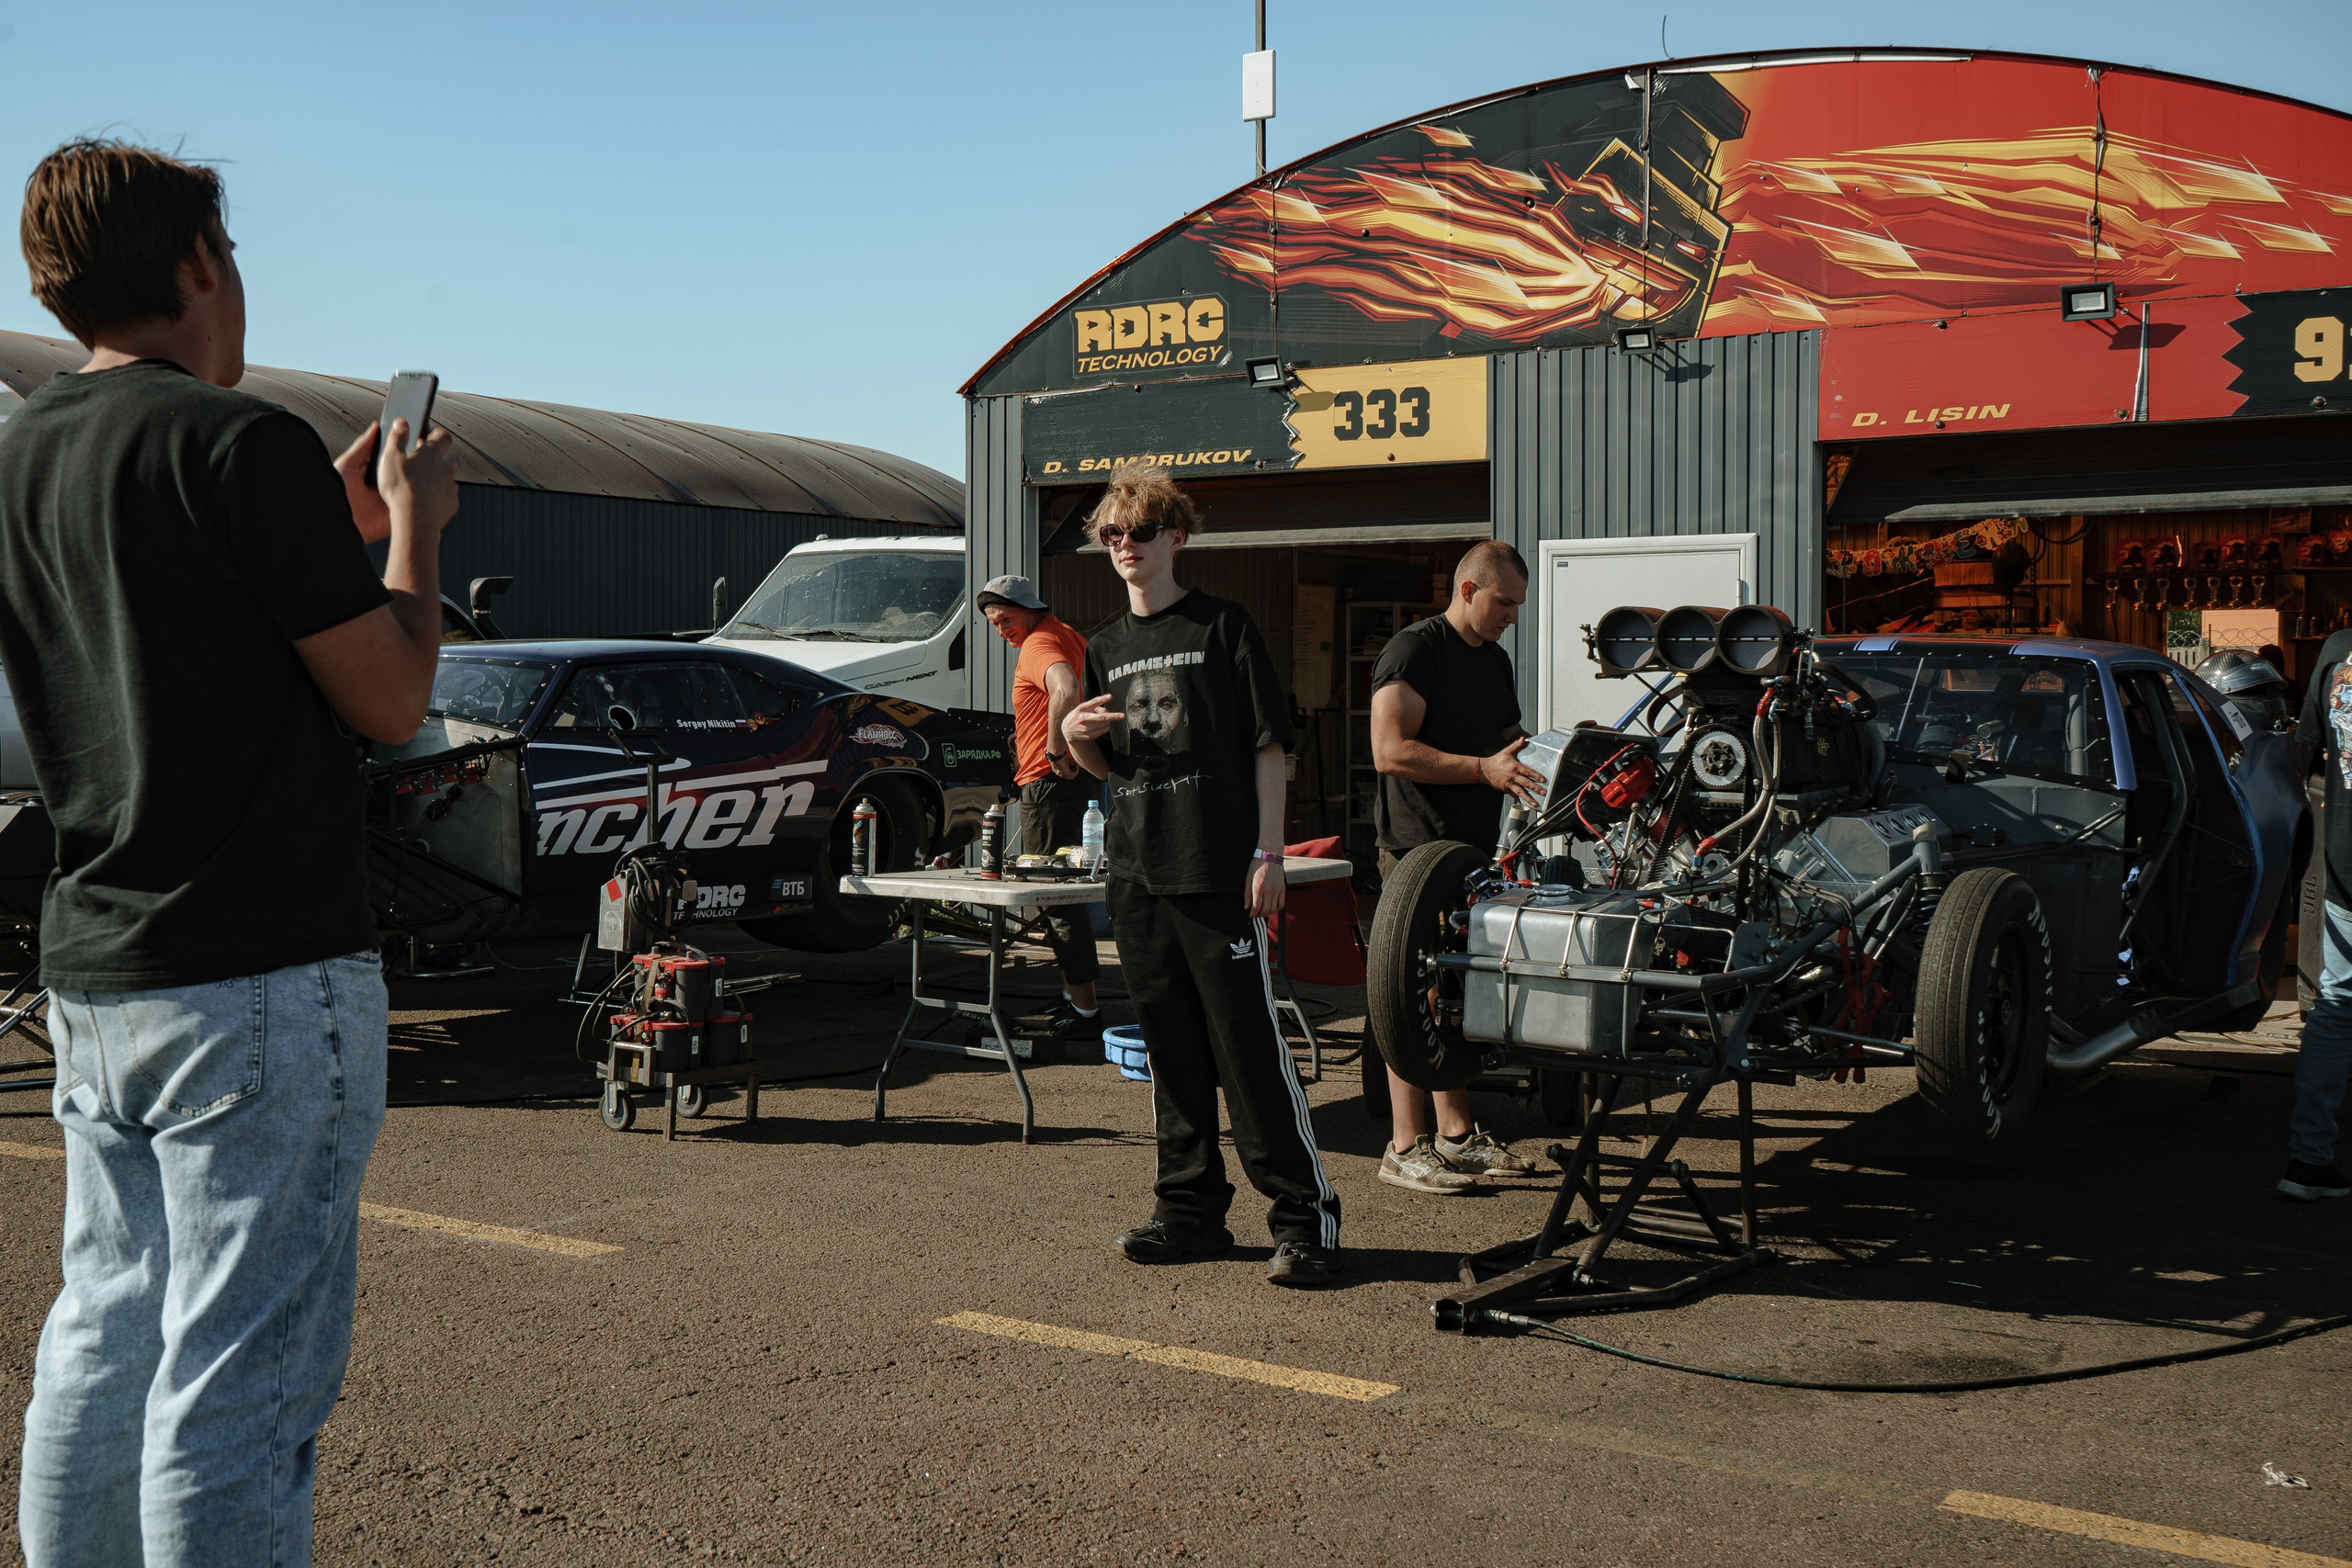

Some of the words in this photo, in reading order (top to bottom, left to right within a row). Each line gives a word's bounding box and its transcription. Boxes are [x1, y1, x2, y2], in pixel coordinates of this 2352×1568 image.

[1075, 298, 1224, 353] RDRC
[1078, 344, 1223, 374] TECHNOLOGY
[2294, 316, 2352, 382] 9
[1334, 386, 1430, 441] 333
[1851, 412, 1888, 427] D.
[1904, 403, 2011, 424] LISIN
[1043, 461, 1069, 475] D.
[676, 718, 707, 730] Sergey
[707, 719, 736, 728] Nikitin
[956, 750, 1001, 761] ЗАРЯДКА.РФ
[677, 885, 745, 910] DRC
[782, 881, 805, 897] ВТБ
[673, 908, 738, 921] TEHNOLOGY
